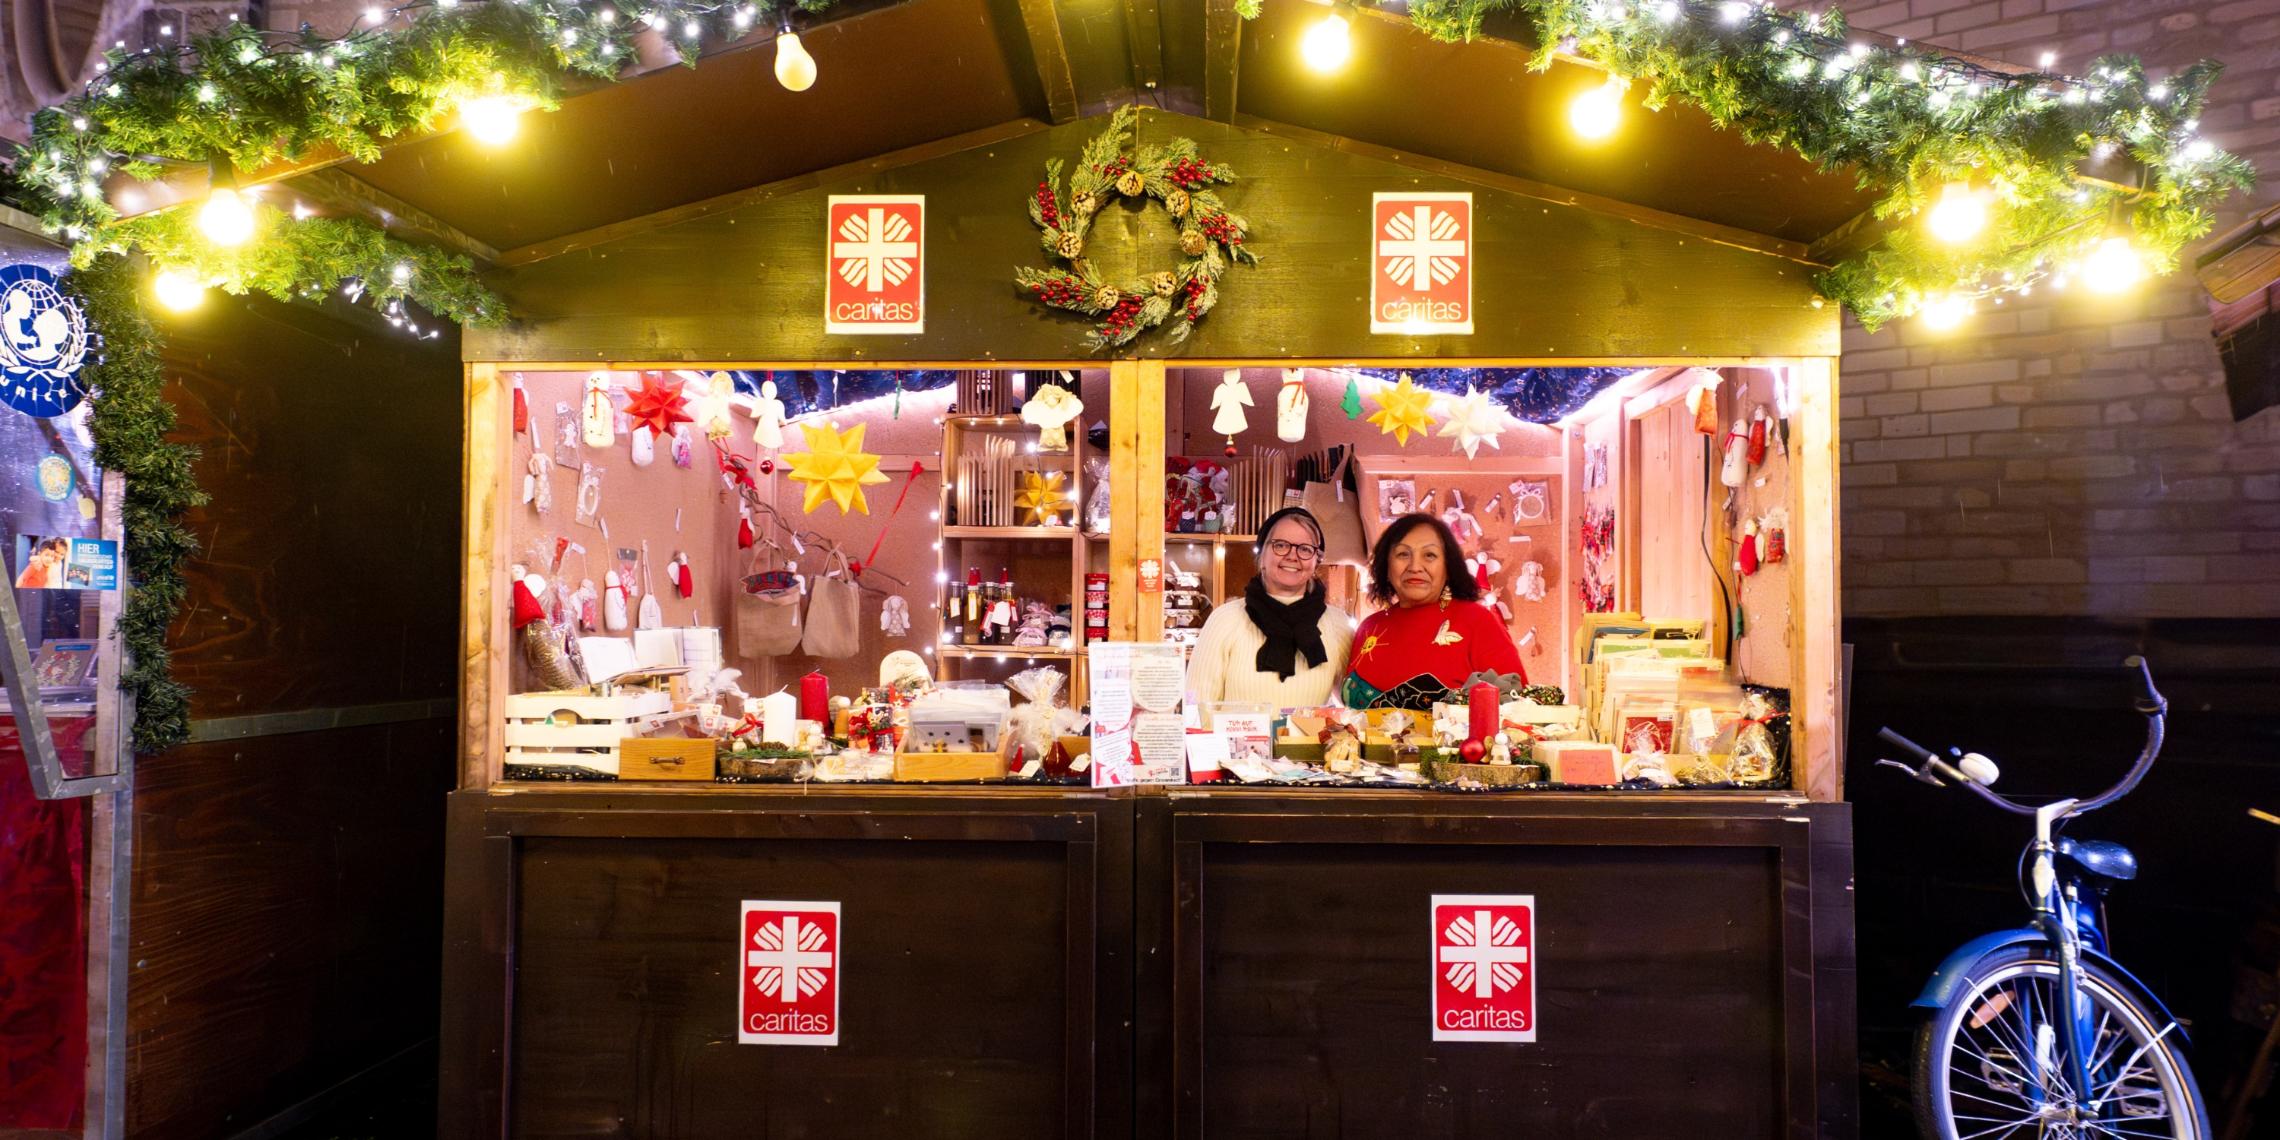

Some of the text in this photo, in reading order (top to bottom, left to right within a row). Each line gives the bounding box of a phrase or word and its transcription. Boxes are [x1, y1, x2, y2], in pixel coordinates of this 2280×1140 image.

[836, 297, 914, 321] caritas
[1382, 296, 1462, 321] caritas
[78, 543, 100, 555] HIER
[750, 1008, 829, 1032] caritas
[1444, 1003, 1525, 1029] caritas
